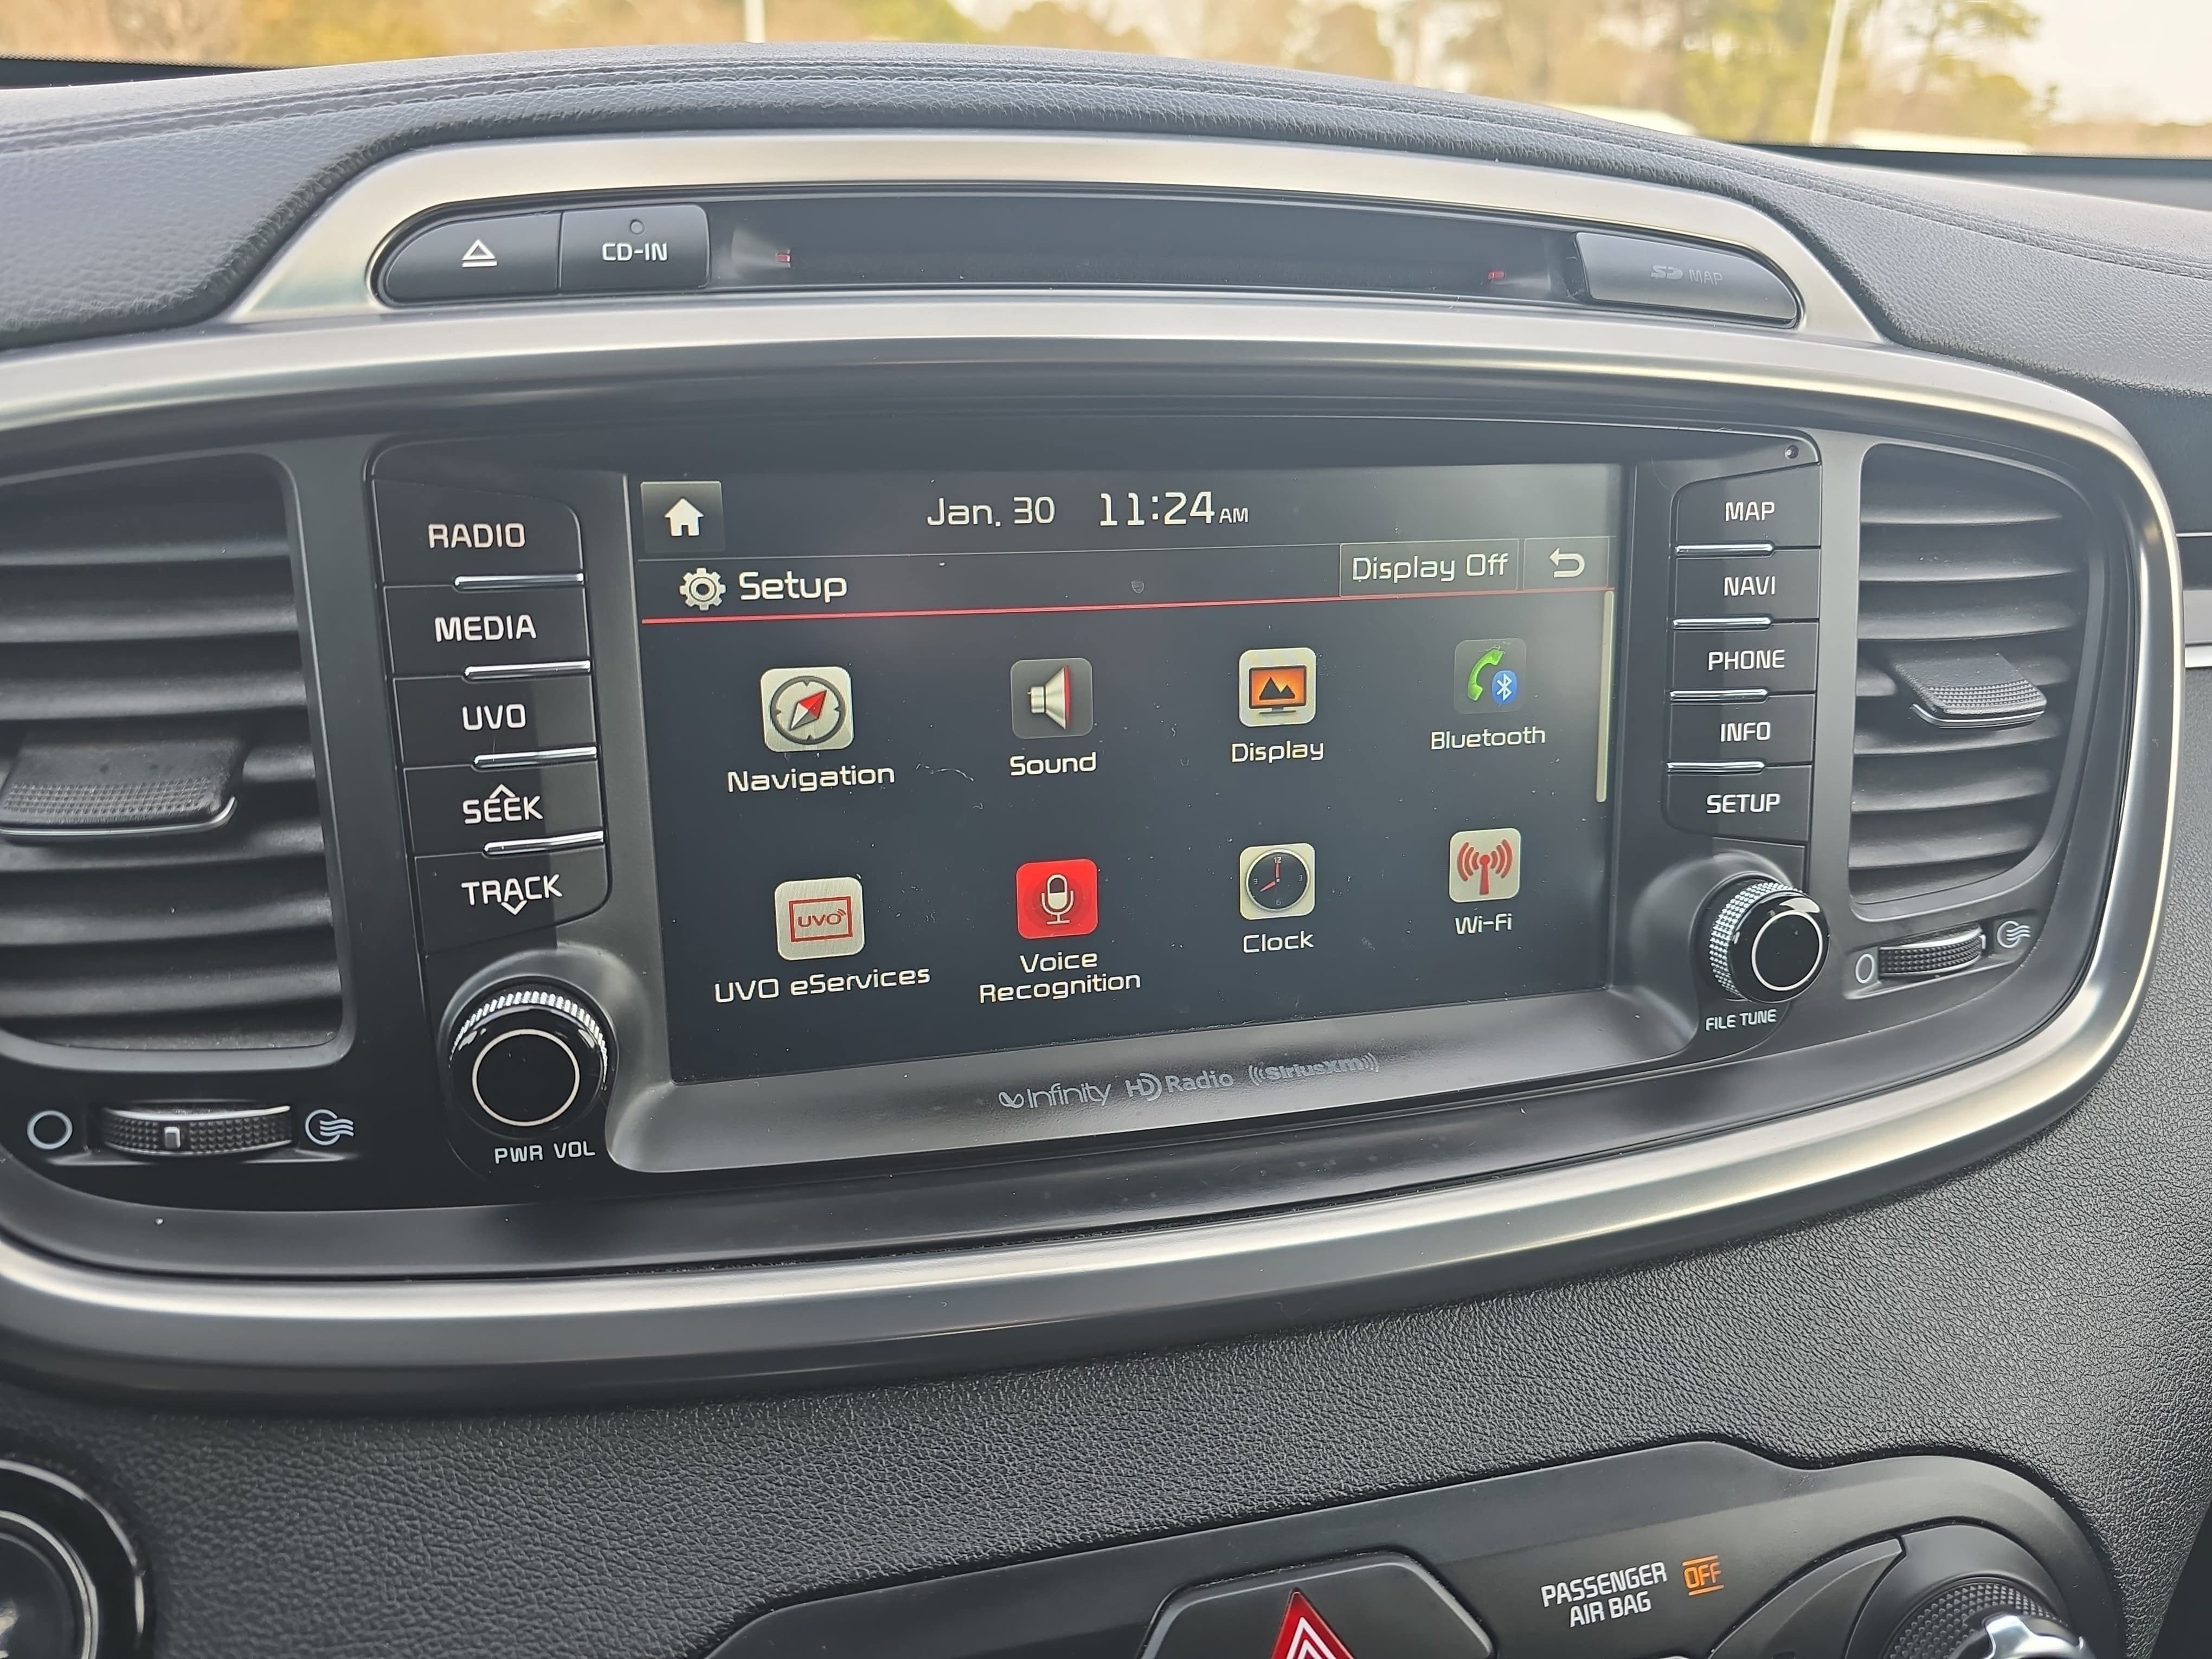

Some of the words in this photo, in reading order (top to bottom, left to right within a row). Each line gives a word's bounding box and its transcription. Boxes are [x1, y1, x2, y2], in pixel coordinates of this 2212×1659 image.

[602, 242, 668, 262] CD-IN
[1688, 268, 1723, 286] MAP
[927, 497, 1002, 528] Jan.
[1013, 496, 1056, 525] 30
[1725, 501, 1776, 522] MAP
[428, 523, 526, 549] RADIO
[1352, 555, 1456, 583] Display
[1465, 554, 1509, 577] Off
[738, 570, 847, 603] Setup
[1723, 576, 1776, 596] NAVI
[434, 614, 537, 642] MEDIA
[1708, 650, 1785, 671] PHONE
[462, 704, 526, 731] UVO
[1430, 725, 1546, 750] Bluetooth
[1720, 721, 1771, 742] INFO
[1010, 752, 1097, 776] Sound
[1231, 739, 1324, 766] Display
[727, 765, 895, 792] Navigation
[462, 795, 544, 825] SEEK
[1706, 793, 1780, 814] SETUP
[461, 874, 563, 906] TRACK
[797, 912, 842, 928] UVO
[1455, 913, 1513, 935] Wi-Fi
[1243, 931, 1314, 953] Clock
[1020, 950, 1098, 974] Voice
[714, 977, 780, 1003] UVO
[790, 966, 930, 995] eServices
[979, 971, 1141, 1004] Recognition
[1705, 1015, 1737, 1031] FILE
[1739, 1009, 1777, 1027] TUNE
[1027, 1082, 1111, 1109] Infinity
[1127, 1072, 1162, 1102] HD
[1167, 1070, 1234, 1094] Radio
[494, 1146, 543, 1165] PWR
[553, 1142, 596, 1159] VOL
[1540, 1561, 1668, 1607] PASSENGER
[1683, 1562, 1721, 1589] OFF
[1570, 1602, 1605, 1628] AIR
[1609, 1591, 1652, 1619] BAG
